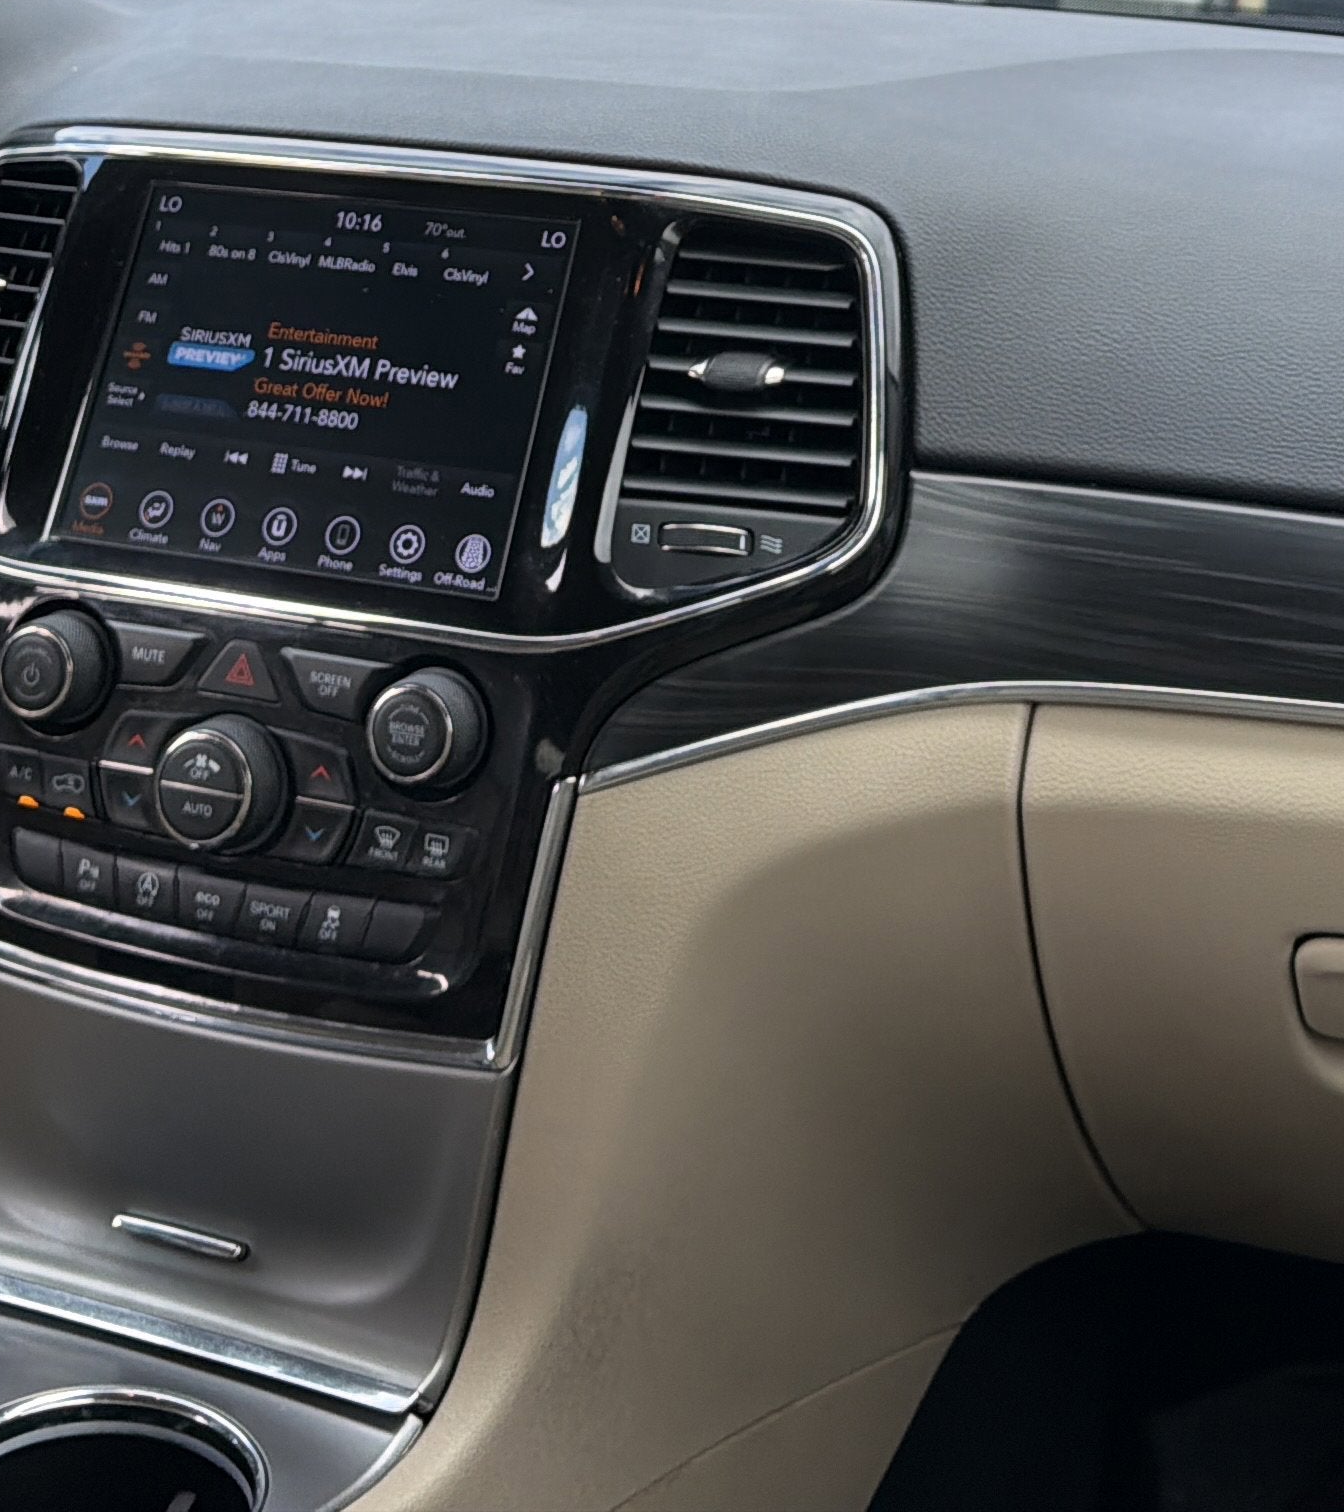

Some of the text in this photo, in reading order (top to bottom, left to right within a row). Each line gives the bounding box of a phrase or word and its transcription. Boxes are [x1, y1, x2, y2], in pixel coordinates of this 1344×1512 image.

[159, 195, 182, 213] LO
[336, 211, 383, 233] 10:16
[541, 230, 567, 249] LO
[208, 245, 256, 261] 80s on 8
[268, 251, 312, 269] ClsVinyl
[318, 254, 376, 273] MLBRadio
[391, 262, 419, 278] Elvis
[148, 273, 169, 286] AM
[443, 268, 489, 287] ClsVinyl
[137, 310, 157, 324] FM
[180, 326, 252, 348] SIRIUSXM
[268, 322, 380, 350] Entertainment
[512, 321, 537, 336] Map
[174, 346, 242, 365] PREVIEW
[263, 346, 460, 389] 1 SiriusXM Preview
[505, 362, 525, 376] Fav
[254, 377, 391, 408] Great Offer Now!
[246, 400, 359, 430] 844-711-8800
[101, 435, 139, 452] Browse
[160, 442, 196, 461] Replay
[291, 458, 317, 474] Tune
[460, 482, 495, 498] Audio
[128, 528, 169, 544] Climate
[199, 538, 222, 552] Nav
[257, 546, 287, 562] Apps
[317, 554, 353, 572] Phone
[378, 563, 423, 583] Settings
[131, 646, 166, 664] MUTE
[309, 670, 352, 688] SCREEN
[318, 685, 339, 698] OFF
[9, 765, 33, 780] A/C
[189, 768, 210, 780] OFF
[182, 800, 213, 818] AUTO
[249, 900, 292, 919] SPORT
[258, 917, 276, 932] ON
[319, 928, 338, 941] OFF
